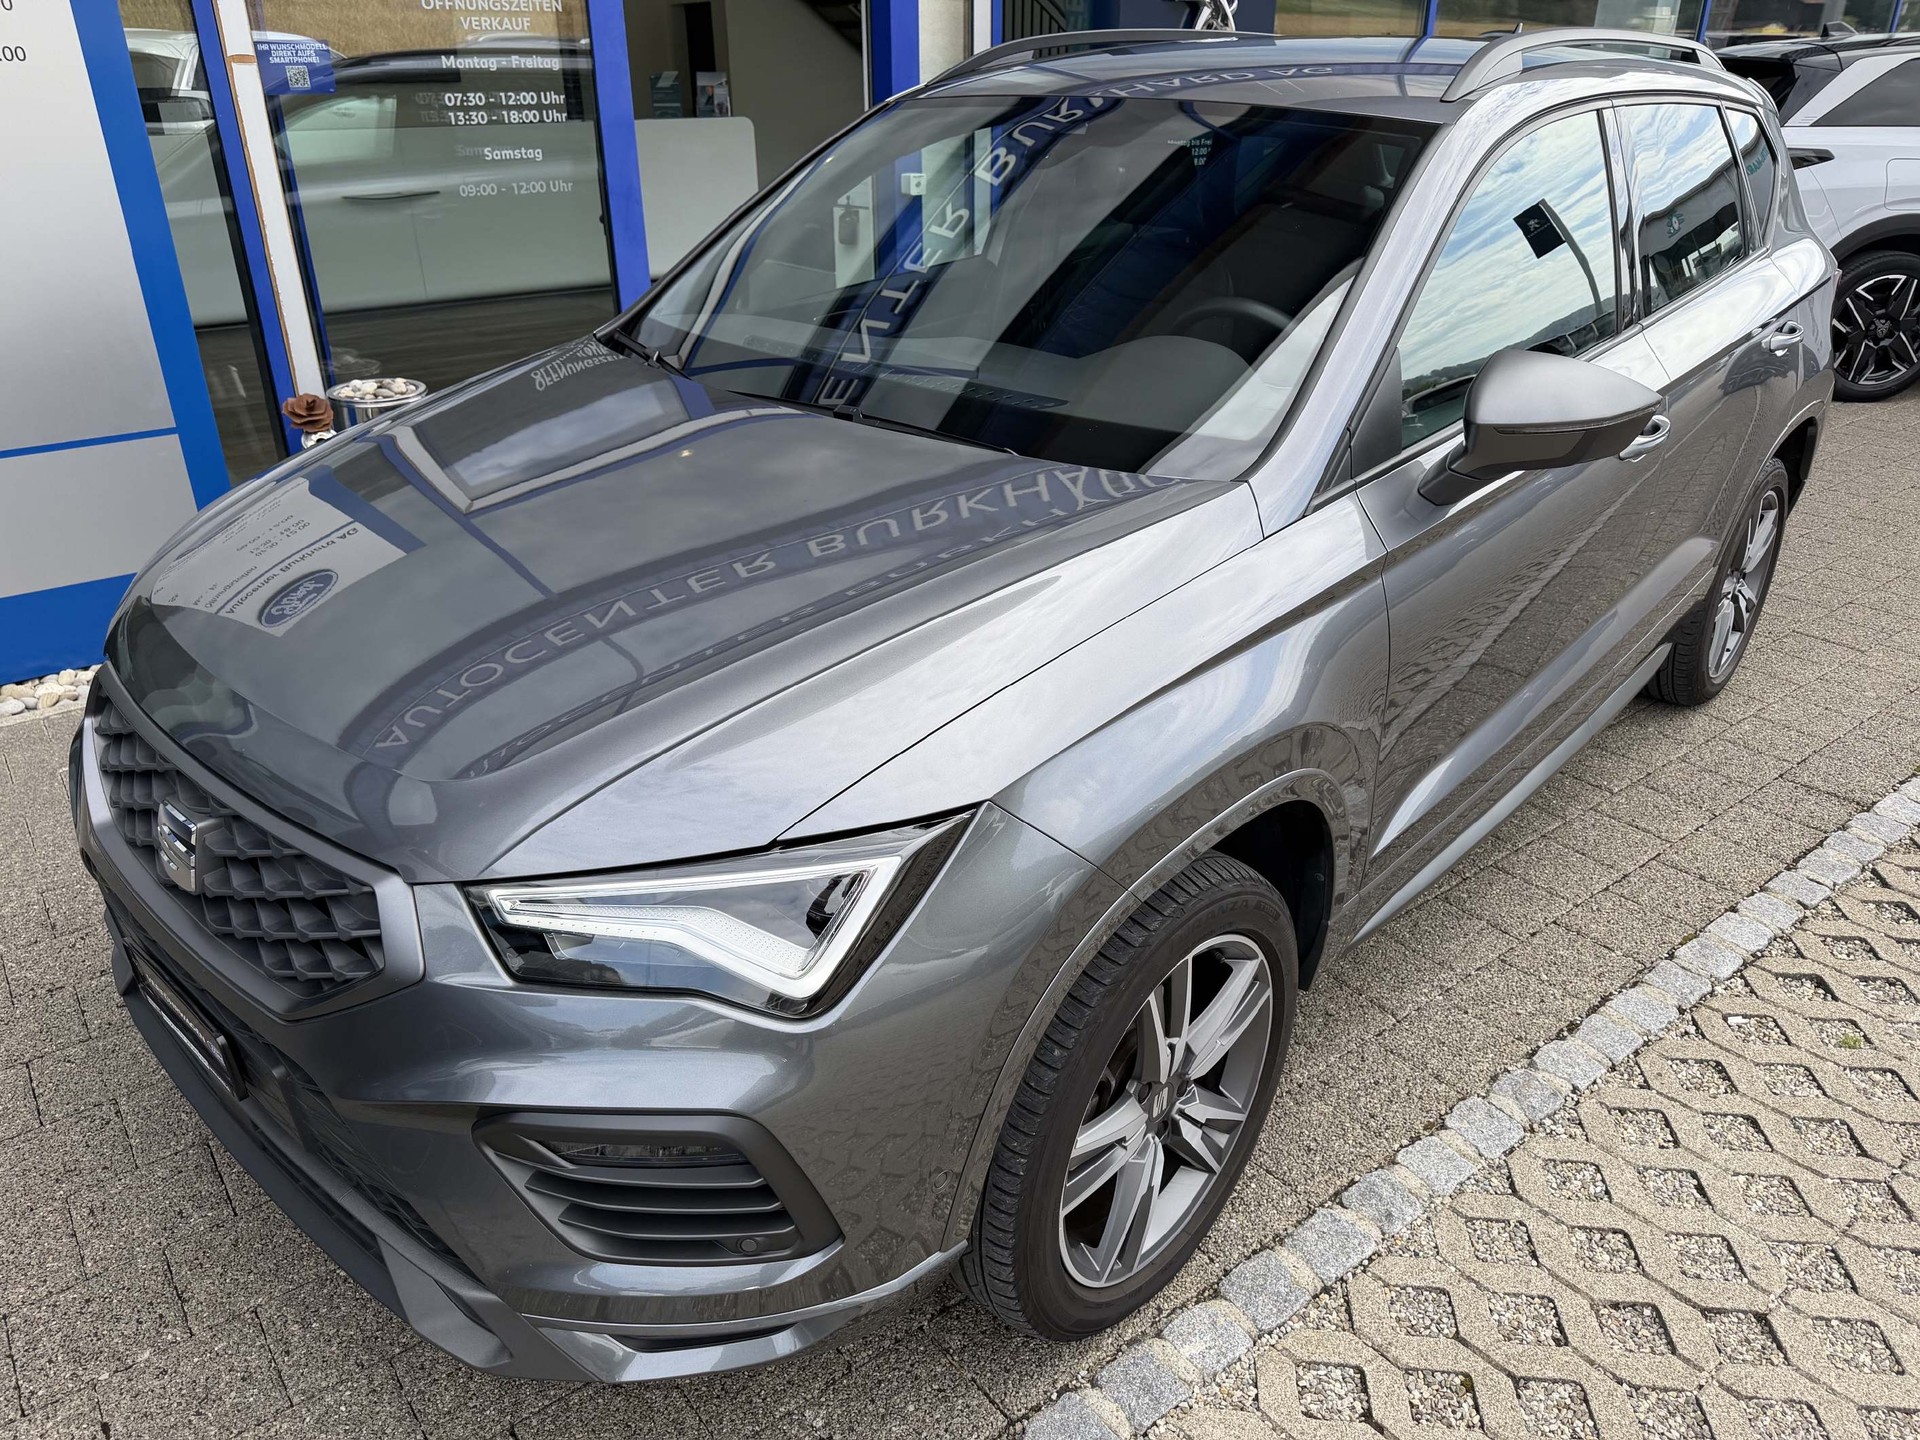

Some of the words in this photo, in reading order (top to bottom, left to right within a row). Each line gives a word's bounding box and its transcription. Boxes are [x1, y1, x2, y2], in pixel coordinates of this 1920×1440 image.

[460, 17, 531, 30] VERKAUF
[270, 43, 328, 51] WUNSCHMODELL
[269, 56, 320, 64] SMARTPHONE!
[441, 55, 497, 71] Montag
[511, 55, 560, 71] Freitag
[445, 92, 486, 106] 07:30
[499, 91, 537, 105] 12:00
[540, 91, 565, 105] Uhr
[448, 111, 488, 126] 13:30
[502, 110, 539, 124] 18:00
[543, 109, 567, 123] Uhr
[484, 147, 543, 162] Samstag
[459, 183, 497, 198] 09:00
[512, 181, 547, 195] 12:00
[550, 180, 573, 193] Uhr
